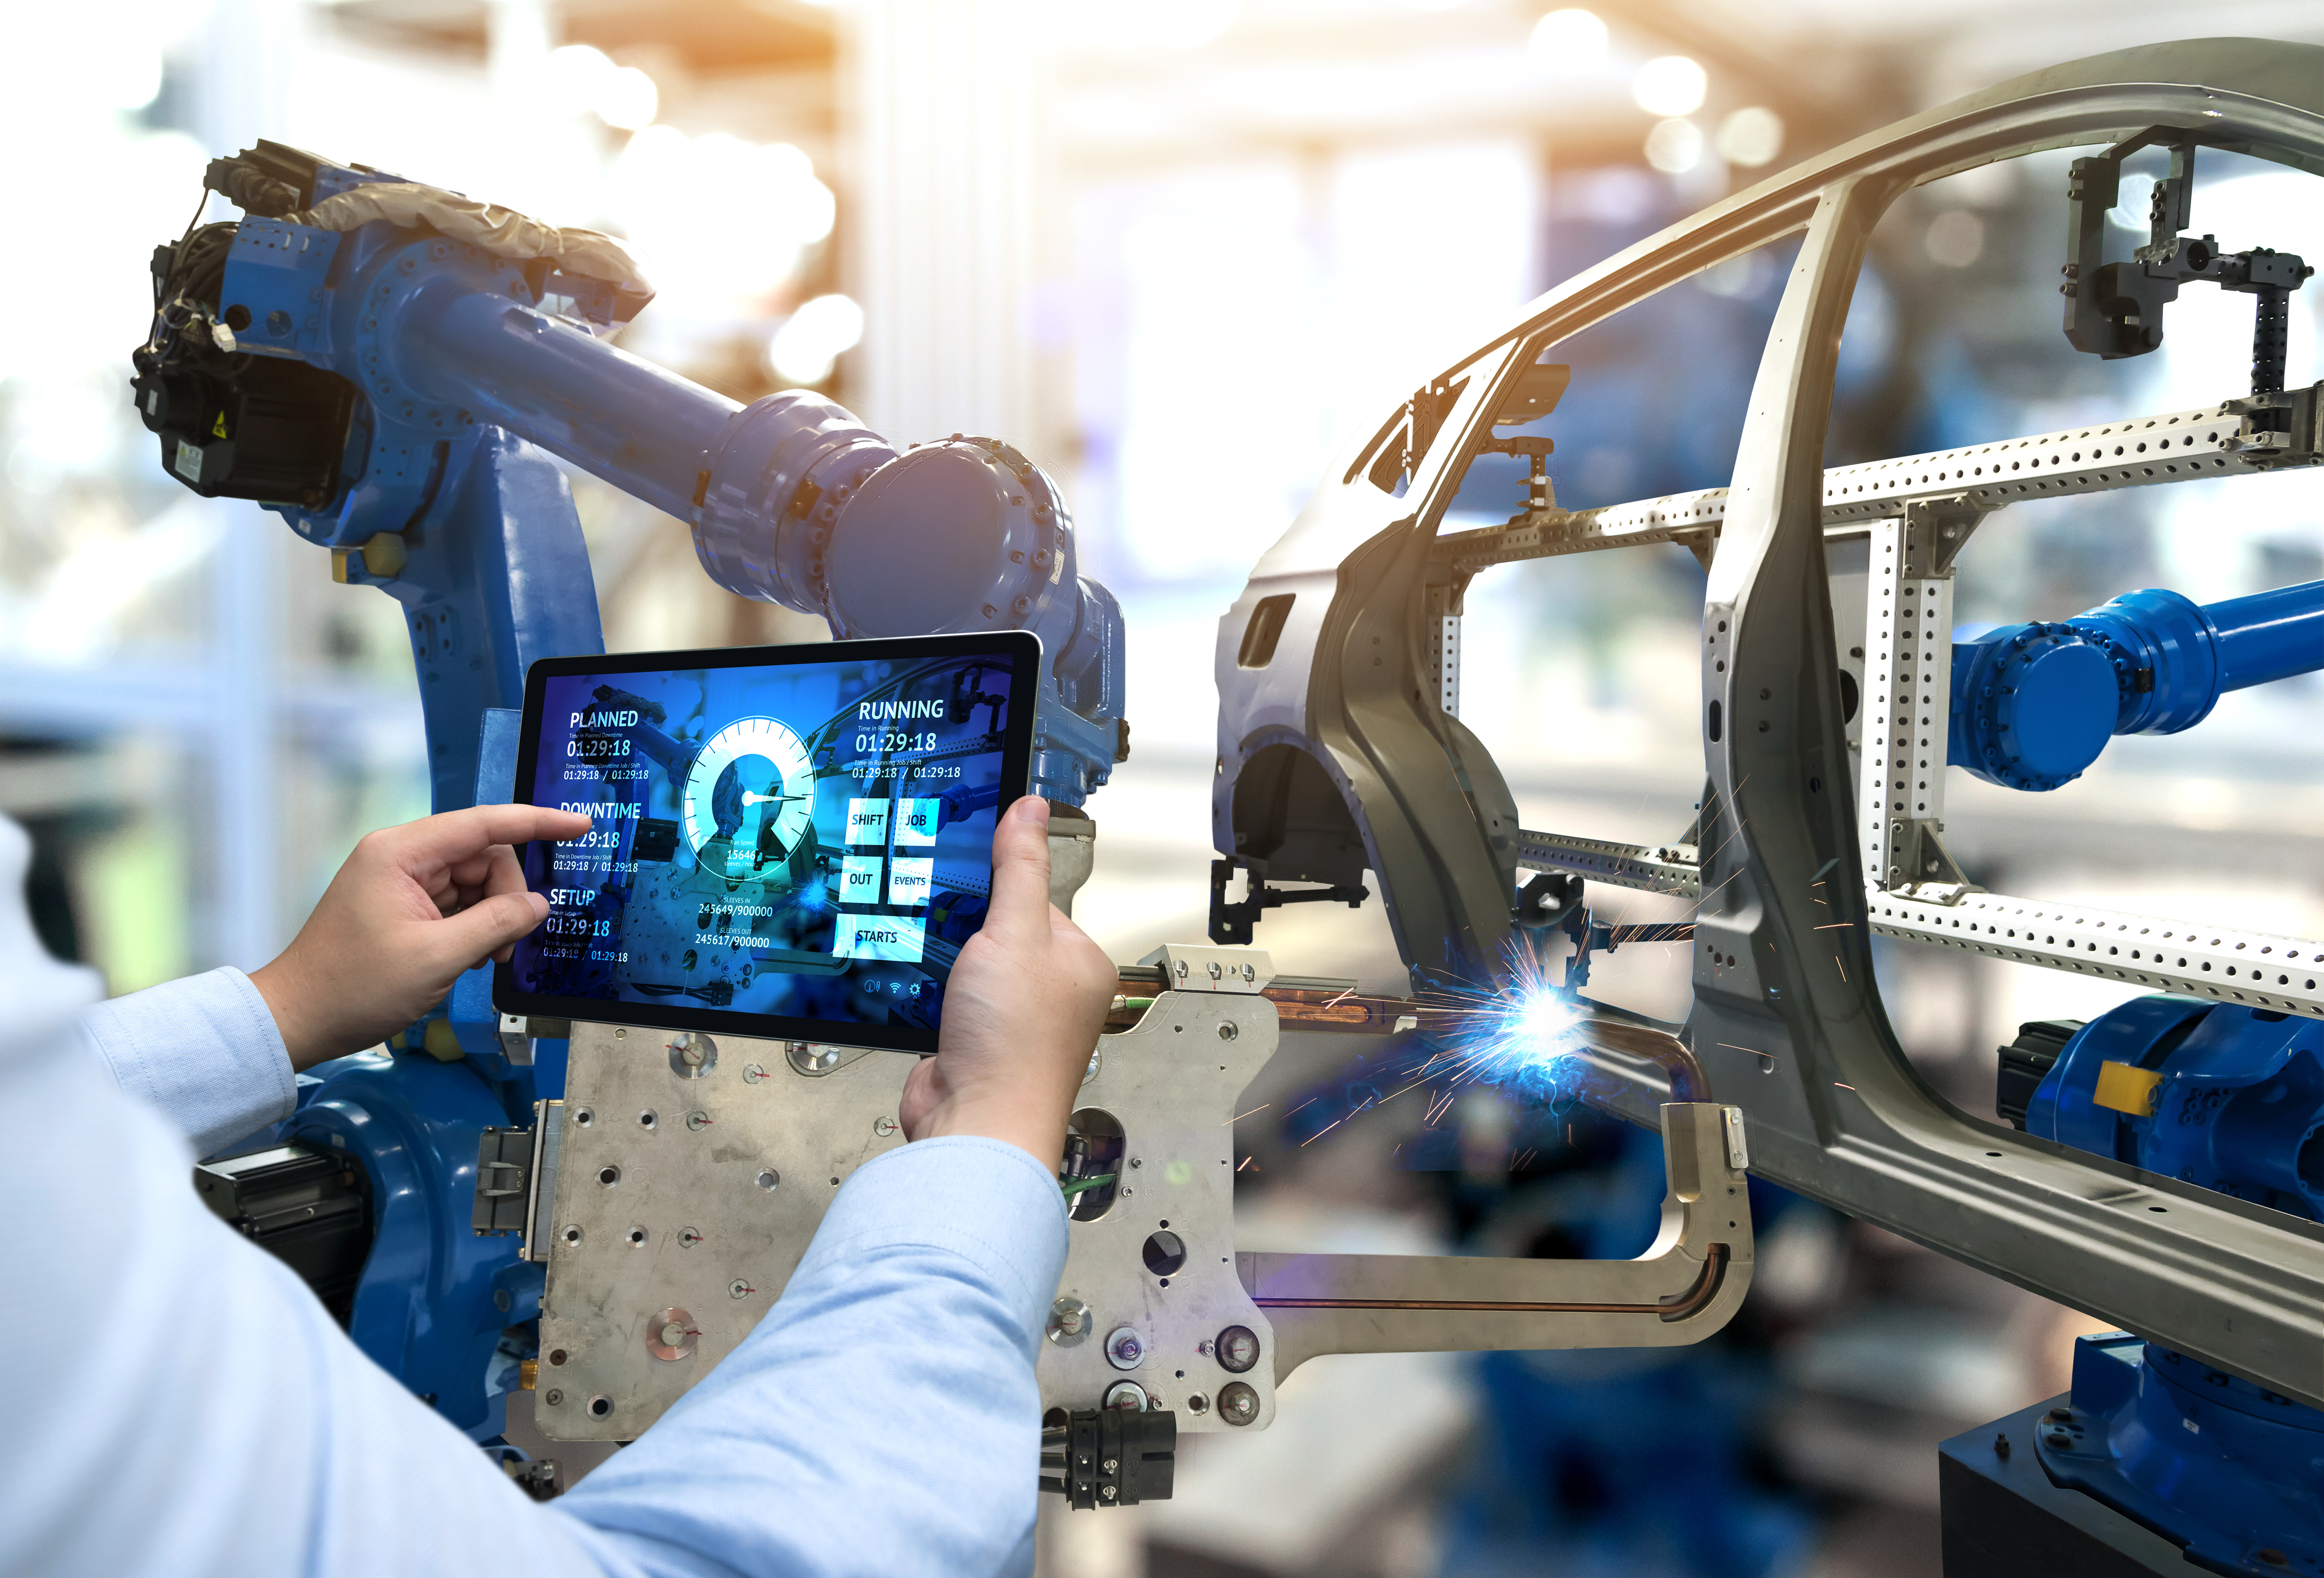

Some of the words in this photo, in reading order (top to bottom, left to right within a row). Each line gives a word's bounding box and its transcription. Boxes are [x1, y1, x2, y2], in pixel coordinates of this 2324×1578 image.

[859, 699, 944, 720] RUNNING
[570, 710, 638, 728] PLANNED
[567, 740, 631, 757] 01:29:18
[856, 732, 936, 752] 01:29:18
[564, 770, 599, 780] 01:29:18
[603, 770, 608, 781] /
[612, 770, 649, 780] 01:29:18
[852, 767, 897, 778] 01:29:18
[902, 767, 909, 780] /
[913, 767, 961, 778] 01:29:18
[851, 814, 884, 826] SHIFT
[905, 814, 927, 826] JOB
[727, 849, 755, 860] 15646
[554, 860, 589, 871] 01:29:18
[592, 862, 598, 872] /
[601, 862, 638, 873] 01:29:18
[849, 873, 873, 885] OUT
[894, 876, 926, 886] EVENTS
[549, 888, 596, 906] SETUP
[698, 903, 773, 917] 245649/900000
[547, 917, 610, 937] 01:29:18
[695, 934, 769, 947] 245617/900000
[856, 930, 898, 943] STARTS
[544, 947, 578, 959] 01:29:18
[582, 950, 588, 961] /
[591, 950, 628, 963] 01:29:18
